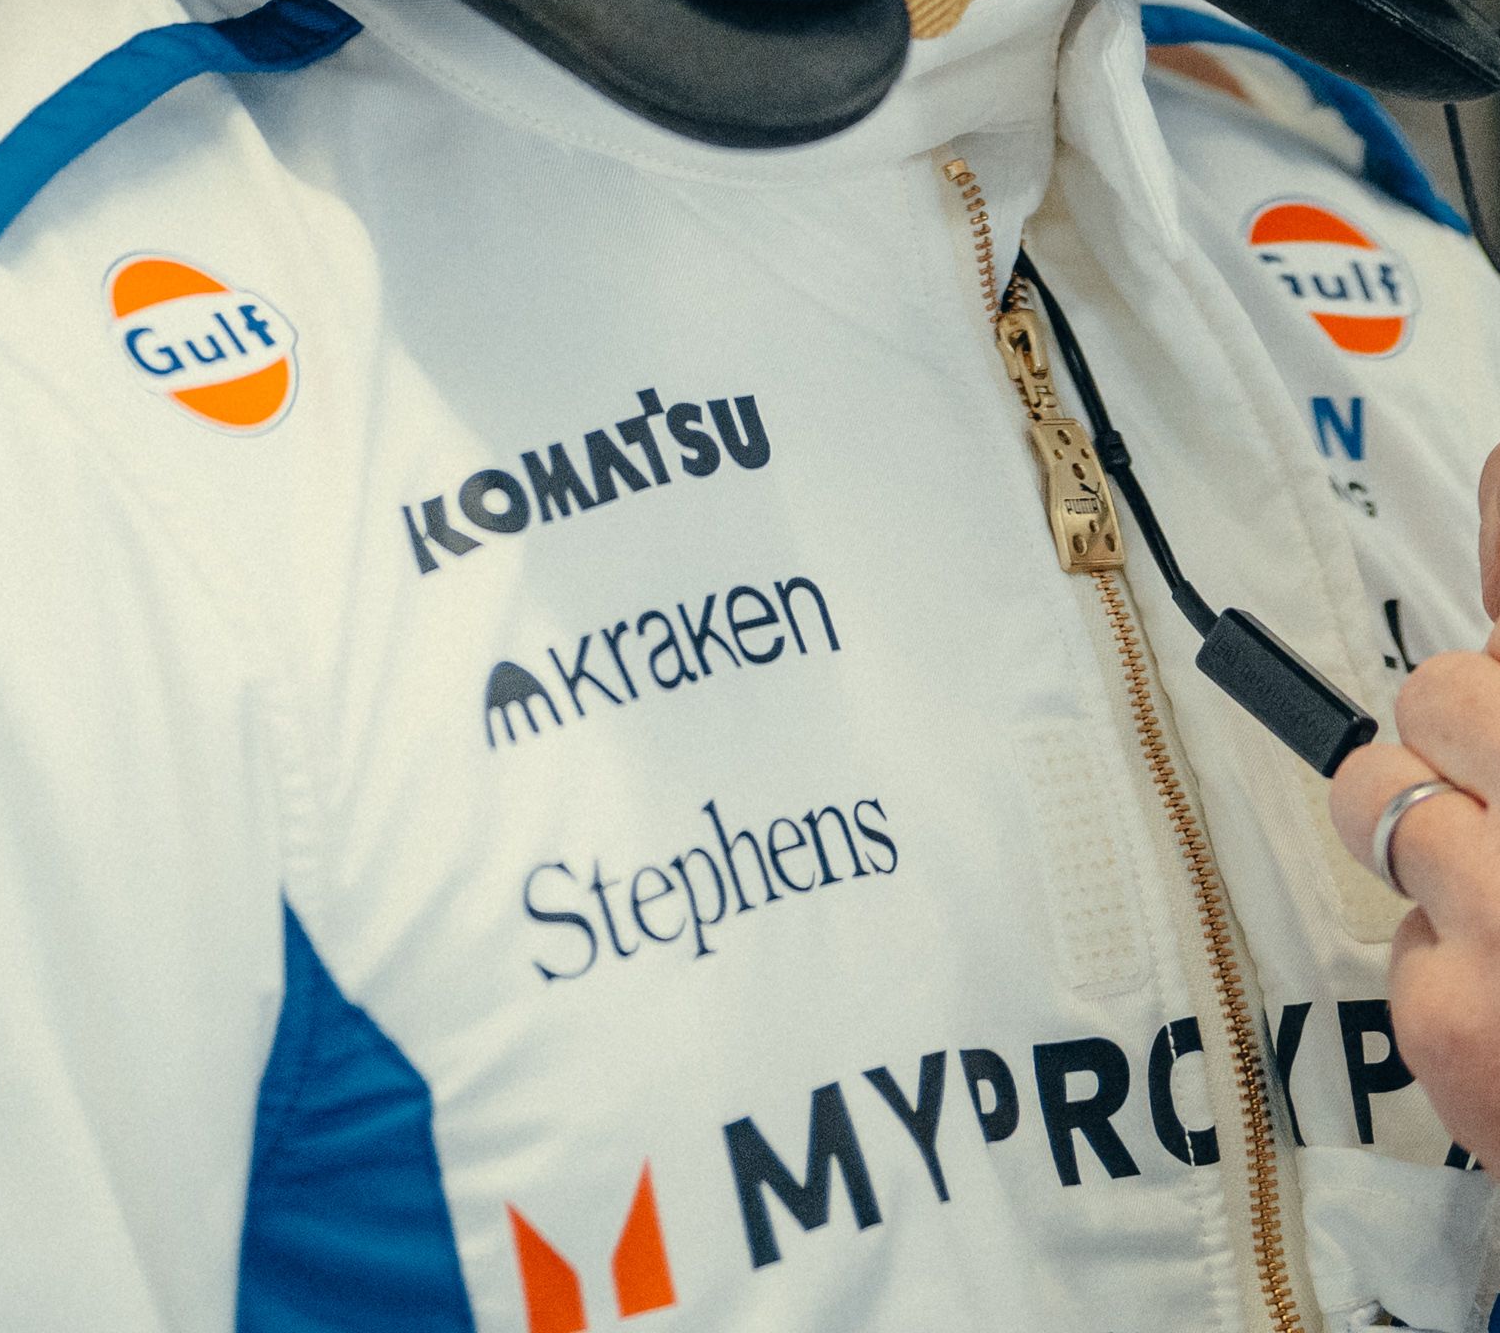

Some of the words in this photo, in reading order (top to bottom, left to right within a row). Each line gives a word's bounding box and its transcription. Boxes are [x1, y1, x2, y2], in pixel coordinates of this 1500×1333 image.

[124, 304, 280, 378] Gulf
[401, 387, 773, 575] KOMATSU
[522, 795, 900, 983] Stephens
